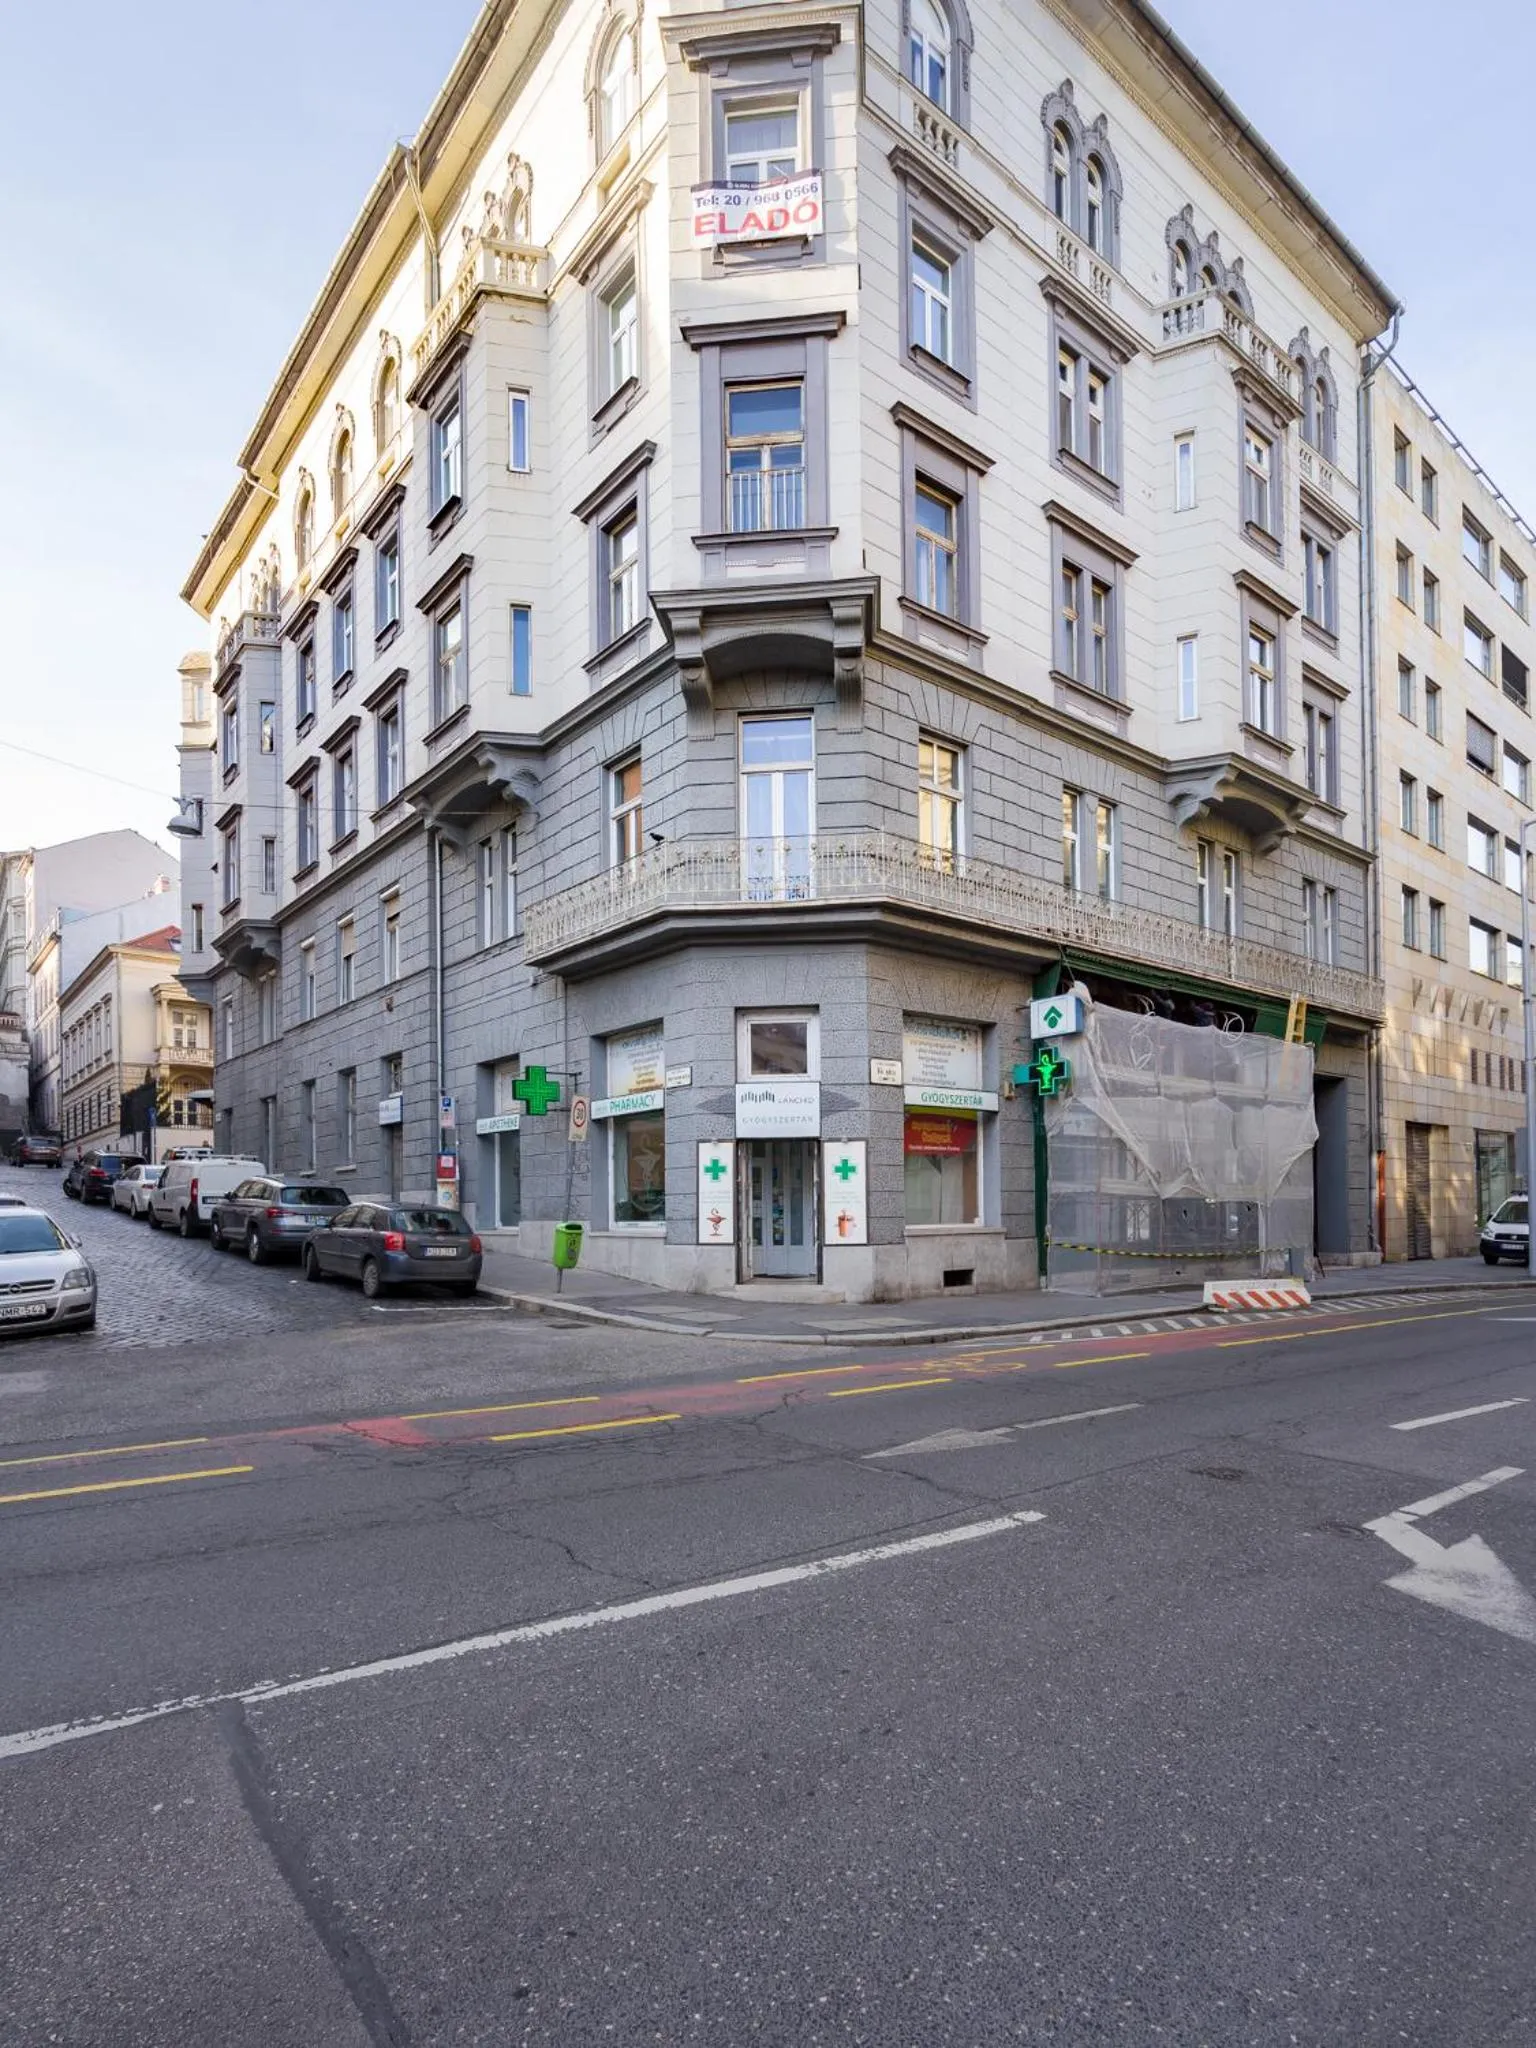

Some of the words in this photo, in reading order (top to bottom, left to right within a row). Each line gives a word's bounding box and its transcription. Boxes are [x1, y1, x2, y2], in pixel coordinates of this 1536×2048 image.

[724, 194, 741, 206] 20
[694, 197, 819, 237] ELADÓ
[609, 1094, 656, 1113] PHARMACY
